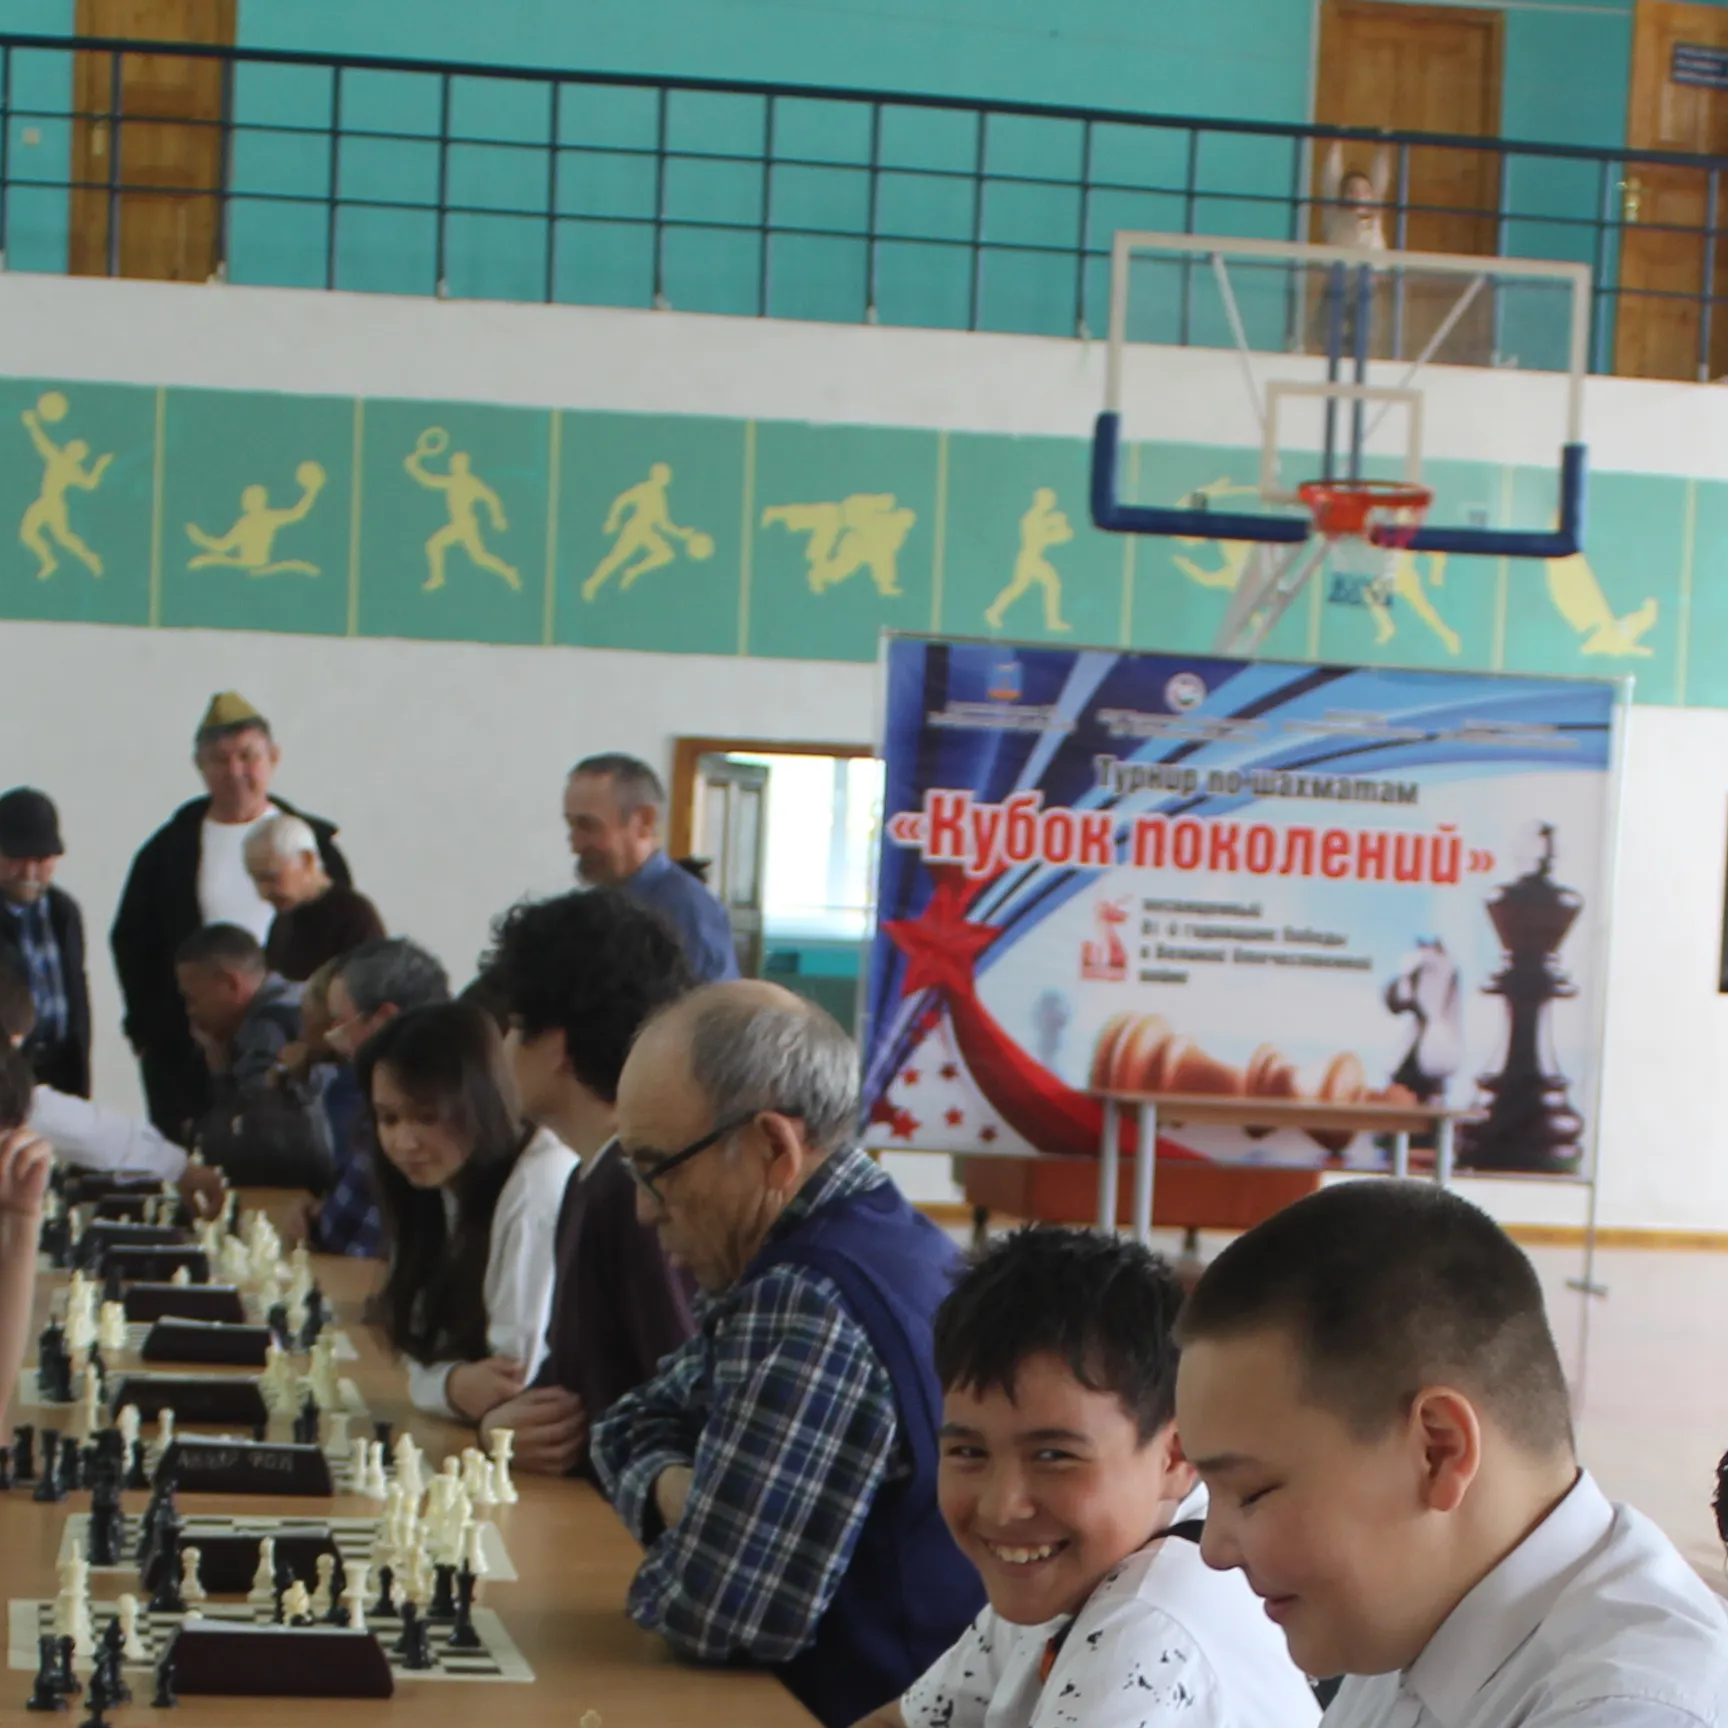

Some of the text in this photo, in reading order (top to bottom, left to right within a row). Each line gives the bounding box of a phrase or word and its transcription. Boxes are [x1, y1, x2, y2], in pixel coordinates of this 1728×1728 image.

[1093, 754, 1198, 796] Турнир
[889, 792, 1496, 886] «Кубок поколений»
